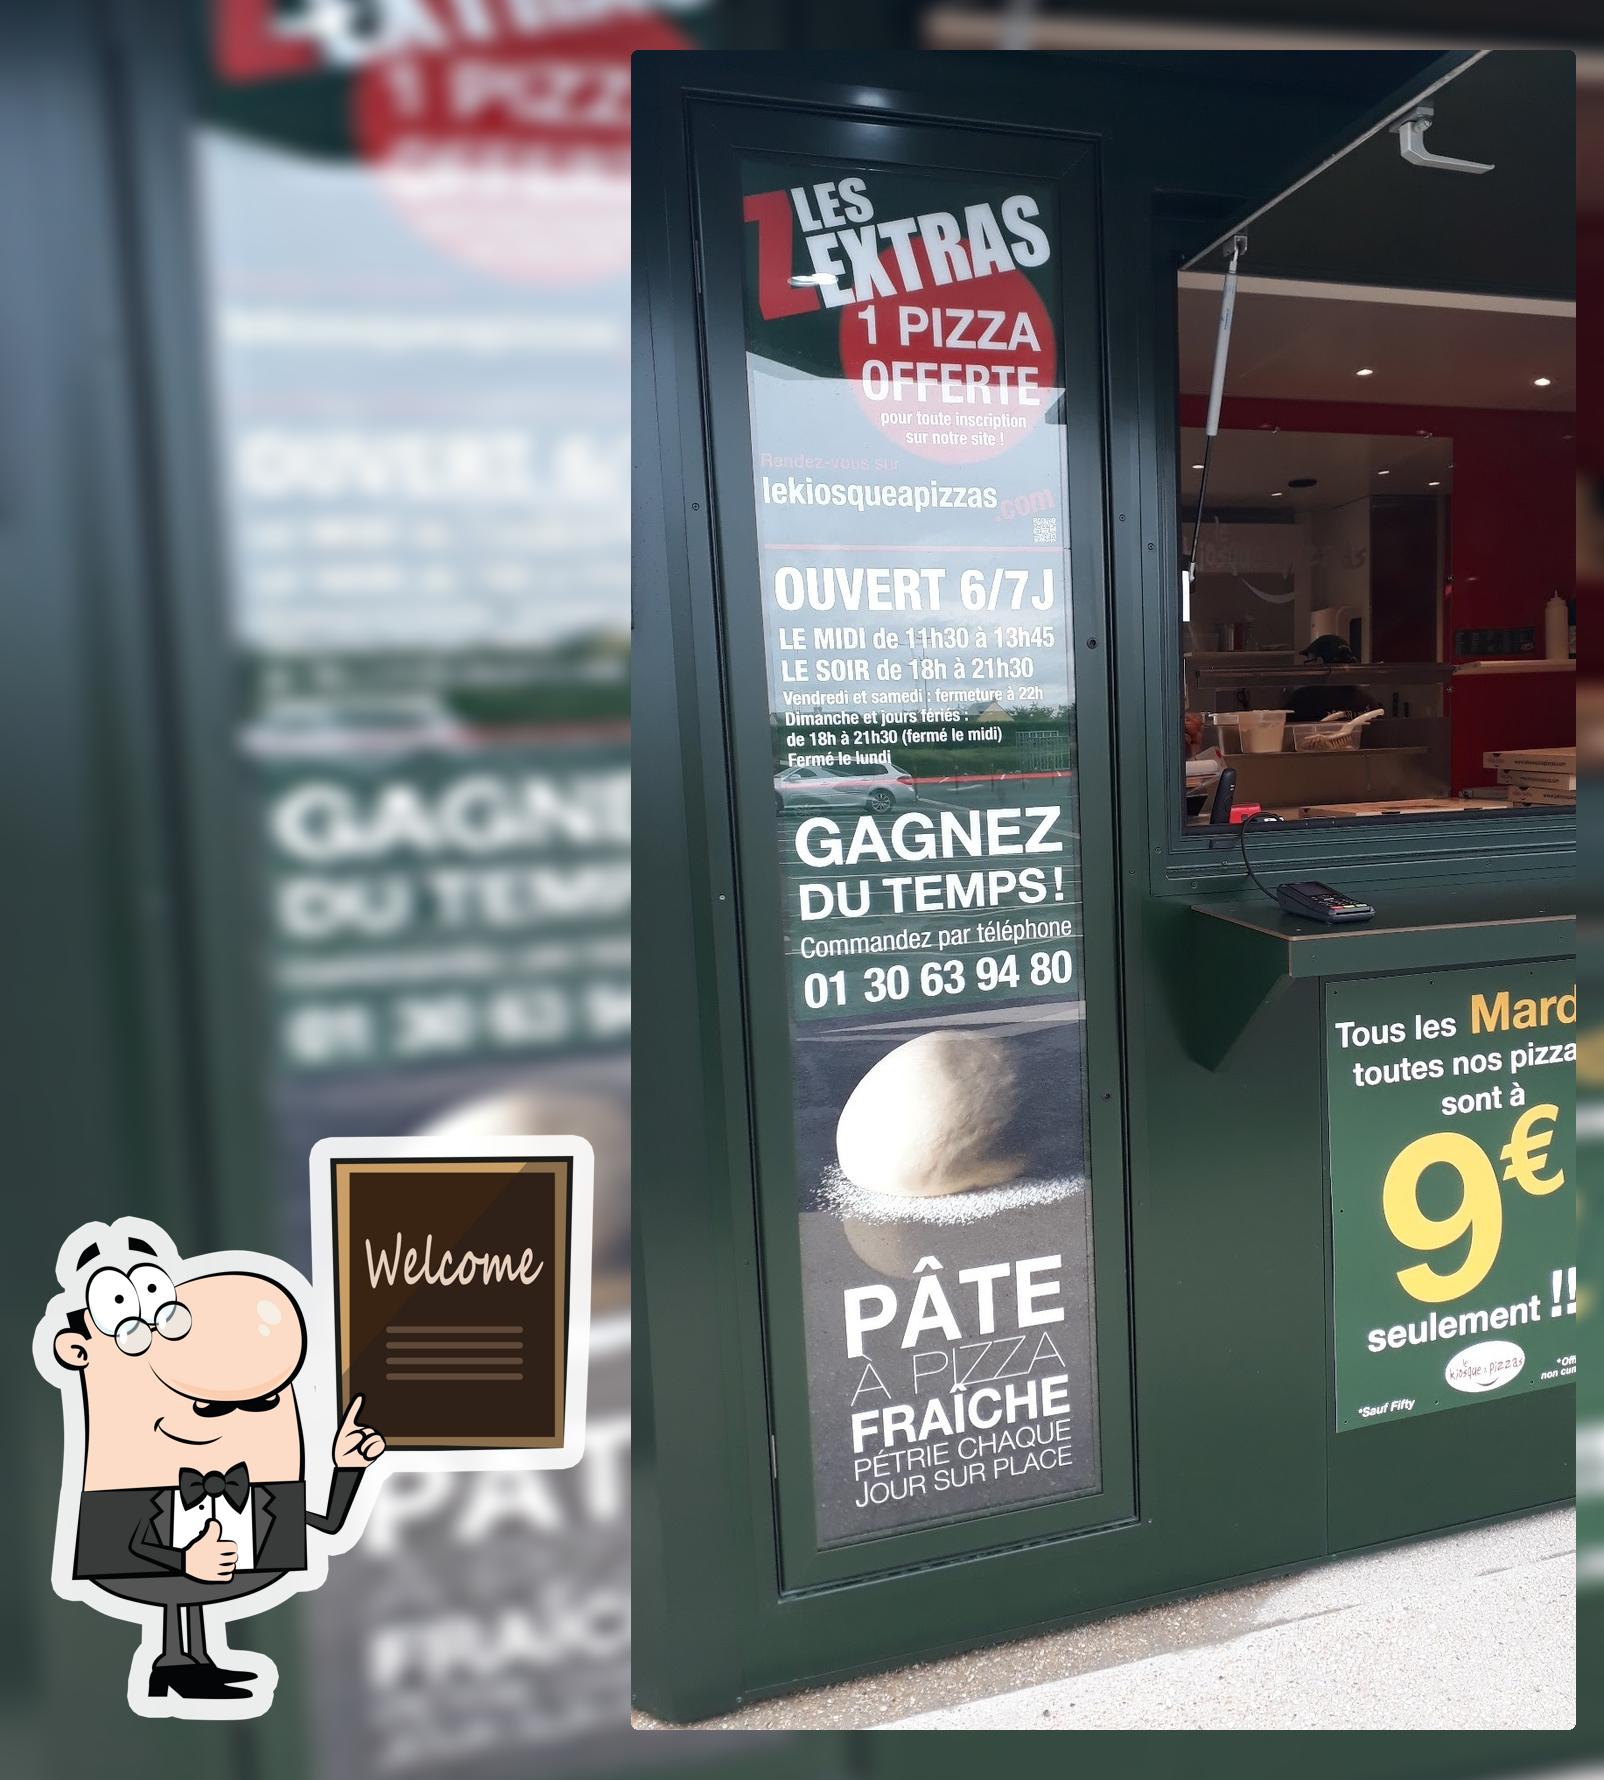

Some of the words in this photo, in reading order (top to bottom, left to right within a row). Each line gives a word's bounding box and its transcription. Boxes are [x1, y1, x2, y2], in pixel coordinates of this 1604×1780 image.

[791, 177, 874, 232] LES
[806, 195, 1051, 309] EXTRAS
[858, 305, 877, 345] 1
[900, 306, 1041, 352] PIZZA
[862, 359, 1040, 406] OFFERTE
[881, 412, 912, 427] pour
[916, 412, 952, 427] toute
[955, 413, 1027, 430] inscription
[906, 432, 928, 445] sur
[932, 431, 968, 446] notre
[971, 431, 997, 446] site
[760, 454, 870, 471] Rendez-vous
[875, 459, 899, 471] sur
[762, 476, 998, 512] lekiosqueapizzas
[993, 488, 1055, 523] .com
[774, 566, 946, 611] OUVERT
[960, 568, 1054, 611] 6/7J
[779, 627, 807, 650] LE
[814, 627, 866, 649] MIDI
[873, 627, 899, 649] de
[905, 627, 969, 649] 11h30
[975, 625, 987, 648] à
[994, 626, 1055, 648] 13h45
[782, 659, 808, 682] LE
[816, 659, 870, 681] SOIR
[876, 660, 902, 681] de
[908, 659, 947, 680] 18h
[953, 657, 966, 679] à
[972, 657, 1034, 679] 21h30
[783, 691, 849, 705] Vendredi
[853, 691, 867, 704] et
[871, 689, 923, 704] samedi
[935, 687, 1002, 703] fermeture
[1006, 686, 1014, 701] à
[1018, 686, 1043, 700] 22h
[785, 711, 859, 726] Dimanche
[864, 711, 877, 725] et
[881, 711, 917, 727] jours
[920, 709, 961, 723] fériés
[786, 732, 806, 747] de
[809, 732, 837, 747] 18h
[840, 730, 850, 745] à
[853, 730, 898, 745] 21h30
[901, 728, 948, 746] (fermé
[951, 727, 965, 742] le
[968, 726, 1002, 743] midi)
[787, 752, 835, 767] Fermé
[838, 751, 852, 766] le
[855, 750, 892, 765] lundi
[795, 805, 1063, 868] GAGNEZ
[800, 880, 871, 921] DU
[800, 929, 932, 959] Commandez
[938, 929, 971, 950] par
[977, 918, 1072, 945] téléphone
[804, 970, 847, 1009] 01
[863, 964, 910, 1003] 30
[920, 959, 965, 997] 63
[976, 954, 1020, 992] 94
[1030, 950, 1072, 986] 80
[1335, 1021, 1406, 1049] Tous
[1415, 1014, 1457, 1040] les
[1353, 1058, 1444, 1087] toutes
[1453, 1052, 1502, 1076] nos
[1510, 1042, 1576, 1074] pizza
[1441, 1085, 1502, 1116] sont
[1509, 1082, 1526, 1107] à
[843, 1254, 1065, 1359] PÂTE
[1368, 1295, 1541, 1353] seulement
[850, 1354, 892, 1407] À
[913, 1331, 1066, 1395] PIZZA
[1449, 1366, 1482, 1380] kiosque
[1489, 1357, 1524, 1376] pizzas
[1541, 1370, 1558, 1380] non
[851, 1374, 1071, 1454] FRAÎCHE
[1390, 1398, 1415, 1412] Fifty
[854, 1442, 950, 1482] PÉTRIE
[958, 1418, 1072, 1460] CHAQUE
[855, 1474, 927, 1508] JOUR
[934, 1462, 986, 1492] SUR
[994, 1445, 1073, 1480] PLACE
